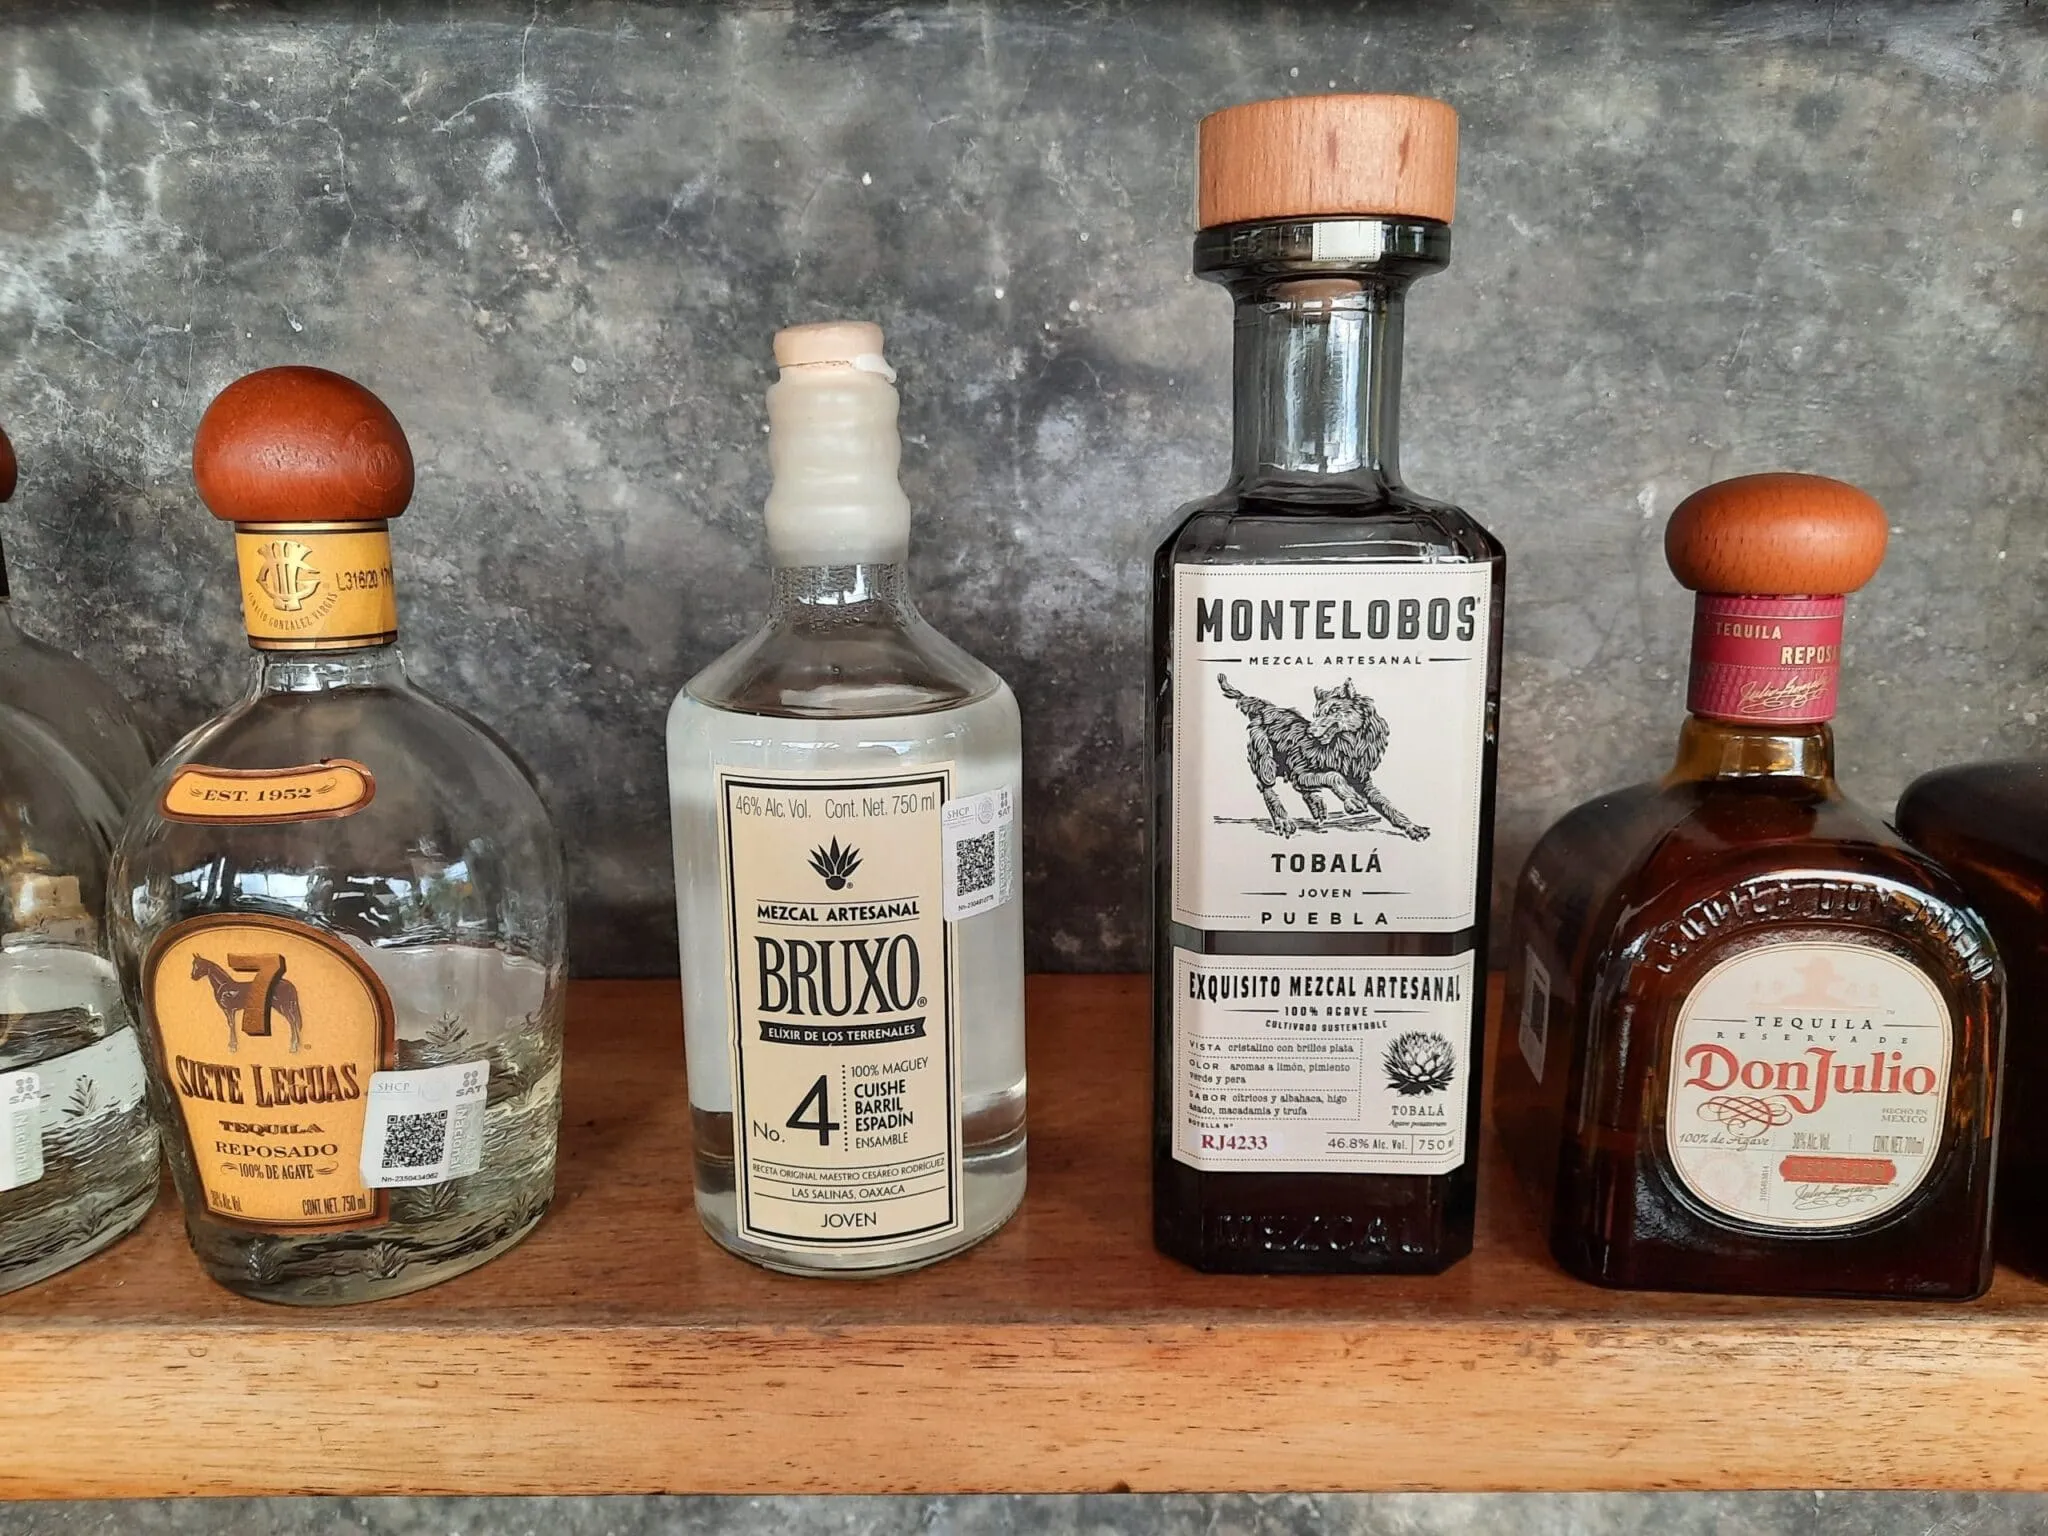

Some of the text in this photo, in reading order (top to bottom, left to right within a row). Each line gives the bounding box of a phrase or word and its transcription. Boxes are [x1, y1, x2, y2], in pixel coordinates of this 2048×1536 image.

[312, 592, 338, 619] VARGAS
[1196, 596, 1477, 642] MONTELOBOS
[1716, 622, 1782, 640] TEQUILA
[1249, 656, 1422, 666] MEZCAL ARTESANAL
[203, 787, 312, 802] EST. 1952
[735, 792, 935, 819] 46% Alc. Vol. Cont. Net. 750 ml
[947, 807, 970, 820] SHCP
[998, 806, 1011, 818] SAT
[1271, 848, 1382, 873] TOBALÁ
[1298, 888, 1352, 898] JOVEN
[756, 901, 920, 921] MEZCAL ARTESANAL
[1261, 912, 1389, 925] PUEBLA
[753, 933, 920, 1016] BRUXO
[1189, 971, 1461, 1003] EXQUISITO MEZCAL ARTESANAL
[1284, 1006, 1369, 1017] 100% AGAVE
[1265, 1019, 1388, 1032] CULTIVADO SUSTENTABLE
[1755, 1016, 1873, 1030] TEQUILA
[768, 1024, 916, 1042] ELÍXIR DE LOS TERRENALES
[1717, 1032, 1857, 1043] RESERVA
[1189, 1039, 1354, 1055] VISTA cristalino con brillos plata
[851, 1056, 929, 1078] 100% MAGUEY
[1189, 1058, 1219, 1071] OLOR
[1230, 1063, 1265, 1072] aromas
[1308, 1062, 1350, 1073] pimiento
[176, 1055, 360, 1107] SIETE LEGUAS
[377, 1082, 410, 1092] SHCP
[854, 1079, 906, 1098] CUISHE
[1215, 1077, 1222, 1085] y
[1224, 1076, 1247, 1085] pera
[455, 1085, 482, 1098] SAT
[1189, 1090, 1227, 1102] SABOR
[1270, 1095, 1277, 1104] y
[1327, 1094, 1347, 1105] higo
[752, 1074, 840, 1146] No. 4
[855, 1096, 903, 1115] BARRIL
[1219, 1106, 1271, 1115] macadamia
[1274, 1108, 1280, 1117] y
[1283, 1106, 1308, 1115] trufa
[1392, 1104, 1445, 1116] TOBALÁ
[219, 1121, 325, 1136] TEQUILA
[855, 1111, 914, 1132] ESPADÍN
[855, 1132, 908, 1149] ENSAMBLE
[1201, 1134, 1268, 1150] RJ4233
[1328, 1138, 1408, 1150] 46.8% Alc. Vol.
[1419, 1139, 1445, 1151] 750
[1680, 1132, 1708, 1144] 100%
[1711, 1132, 1725, 1144] de
[215, 1141, 338, 1158] REPOSADO
[239, 1163, 314, 1179] 100% DE AGAVE
[752, 1163, 778, 1176] RECETA
[779, 1169, 818, 1181] ORIGINAL
[819, 1171, 860, 1182] MAESTRO
[861, 1167, 899, 1180] CESÁREO
[791, 1184, 906, 1200] LAS SALINAS, OAXACA
[302, 1193, 367, 1215] CONT. NET. 750 ml
[821, 1212, 877, 1228] JOVEN
